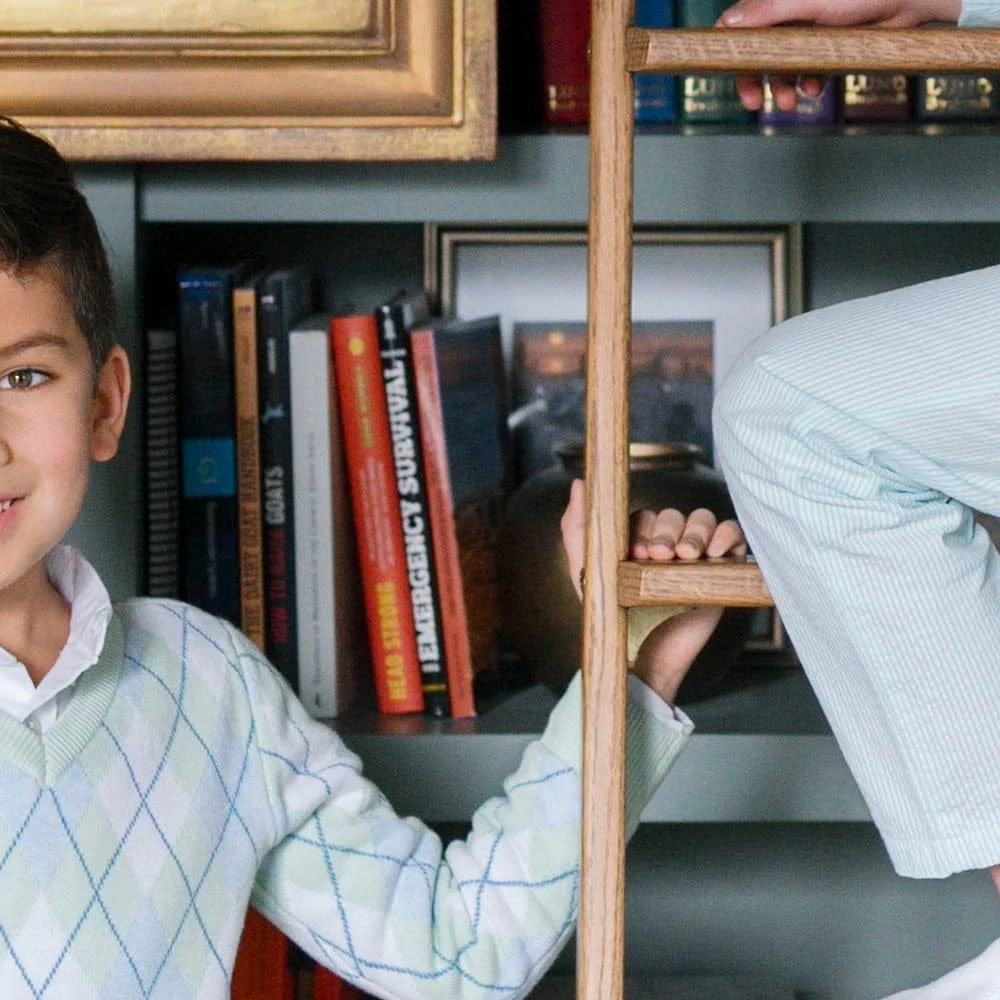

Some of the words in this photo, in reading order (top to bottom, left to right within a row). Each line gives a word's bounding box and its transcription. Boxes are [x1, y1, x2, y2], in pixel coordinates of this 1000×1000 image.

[265, 465, 286, 524] GOATS
[383, 358, 421, 497] SURVIVAL
[400, 500, 440, 665] EMERGENCY
